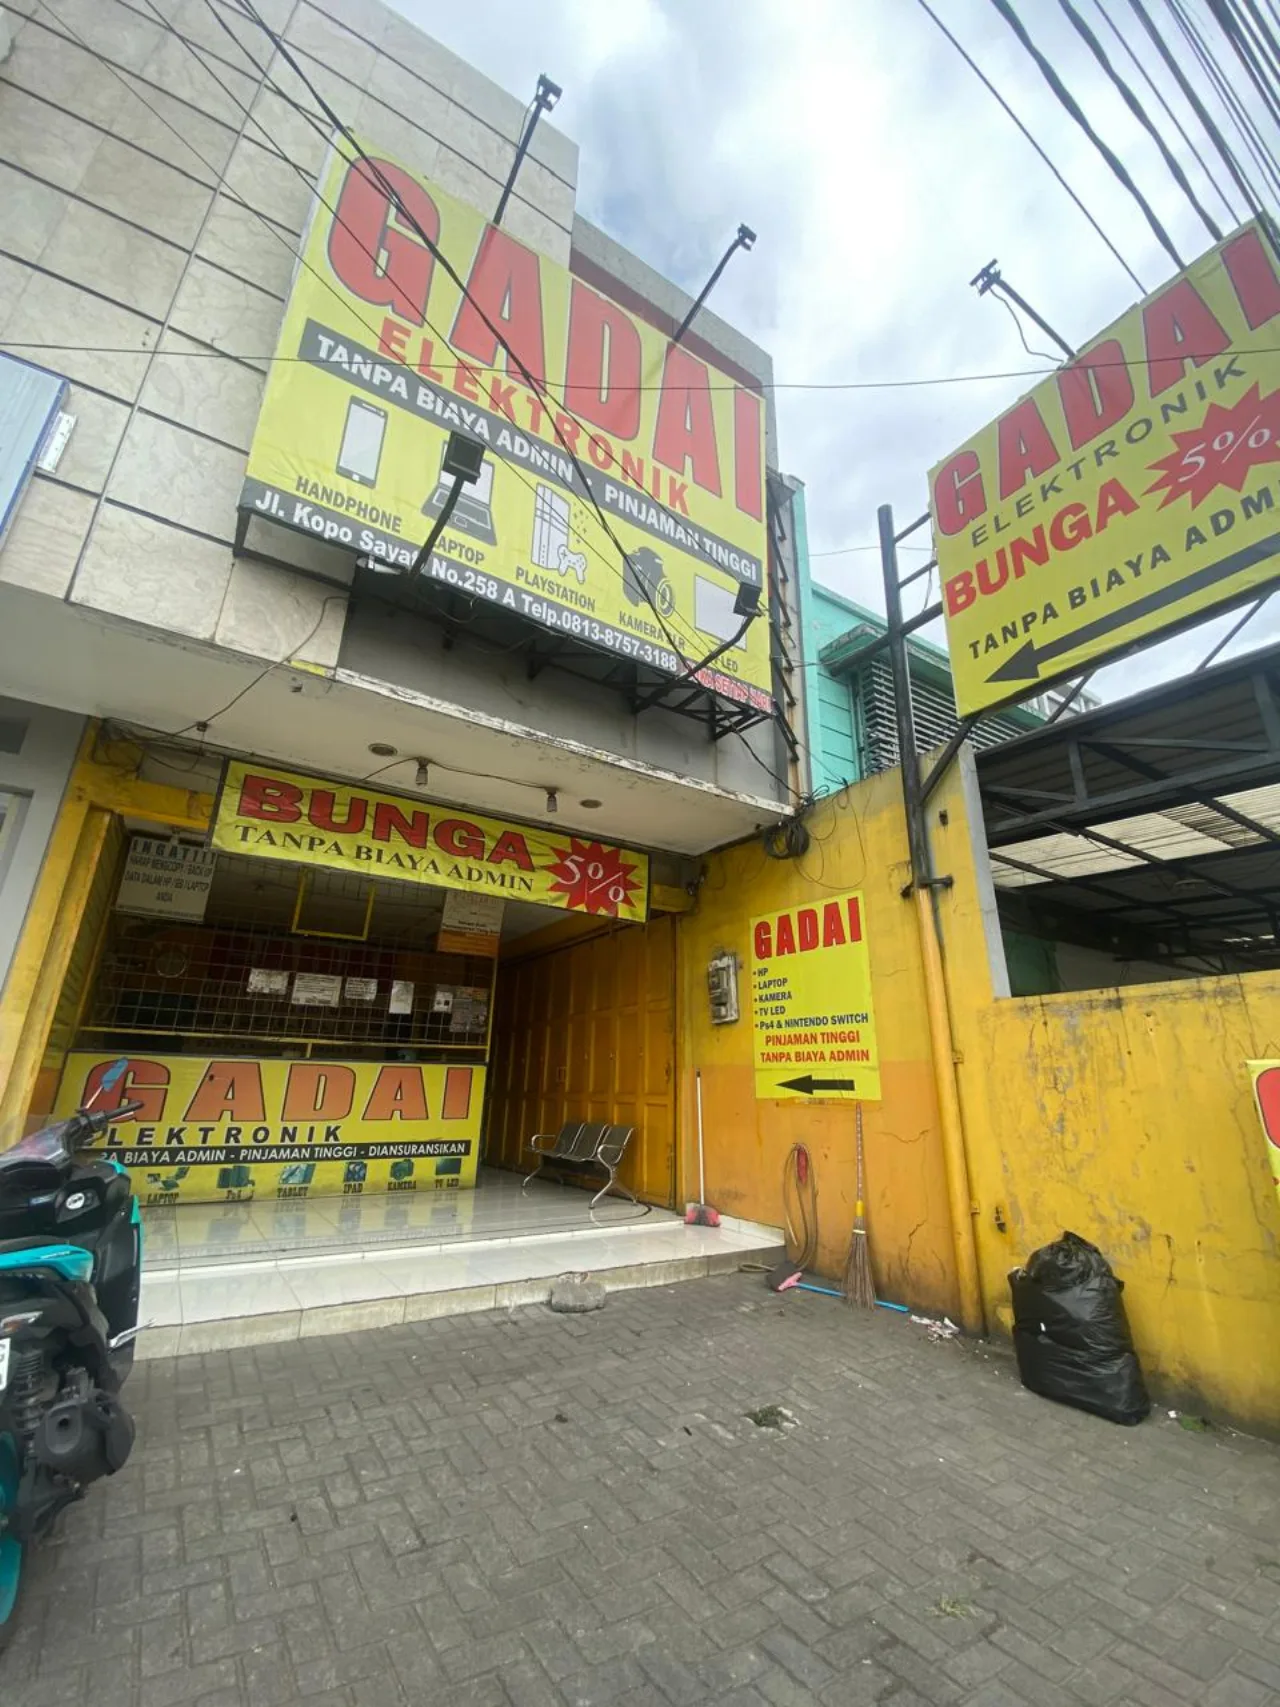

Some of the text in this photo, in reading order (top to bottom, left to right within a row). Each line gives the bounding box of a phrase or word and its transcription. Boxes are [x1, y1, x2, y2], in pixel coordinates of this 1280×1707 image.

[327, 155, 766, 523] GADAI
[933, 226, 1280, 537] GADAI
[377, 317, 690, 516] ELEKTRONIK
[318, 334, 757, 580] TANPA BIAYA ADMIN PINJAMAN TINGGI
[971, 355, 1247, 548] ELEKTRONIK
[295, 475, 403, 533] HANDPHONE
[945, 415, 1271, 618] BUNGA 5%
[434, 535, 485, 565] APTOP
[968, 482, 1280, 659] TANPA BIAYA ADM
[255, 490, 285, 517] Jl.
[293, 502, 353, 542] Kopo
[359, 530, 422, 566] Saya
[431, 557, 498, 599] No.258
[502, 587, 516, 608] A
[521, 593, 677, 672] Telp.0813-8757-3188
[515, 565, 596, 612] PLAYSTATION
[619, 611, 664, 642] KAMERA
[234, 824, 534, 892] TANPA BIAYA ADMIN
[237, 775, 625, 903] BUNGA 5%
[755, 896, 862, 960] GADAI
[757, 967, 769, 977] HP
[758, 978, 788, 990] LAPTOP
[758, 991, 792, 1003] KAMERA
[759, 1006, 786, 1017] TV LED
[759, 1013, 868, 1030] Ps4 & NINTENDO SWITCH
[765, 1030, 860, 1046] PINJAMAN TINGGI
[760, 1050, 869, 1063] TANPA BIAYA ADMIN
[81, 1059, 474, 1121] GADAI
[105, 1125, 342, 1146] LEKTRONIK
[124, 1150, 170, 1164] BIAYA
[175, 1149, 226, 1163] ADMIN
[239, 1147, 310, 1161] PINJAMAN
[313, 1146, 357, 1159] TINGGI
[368, 1143, 465, 1157] DIANSURANSIKAN
